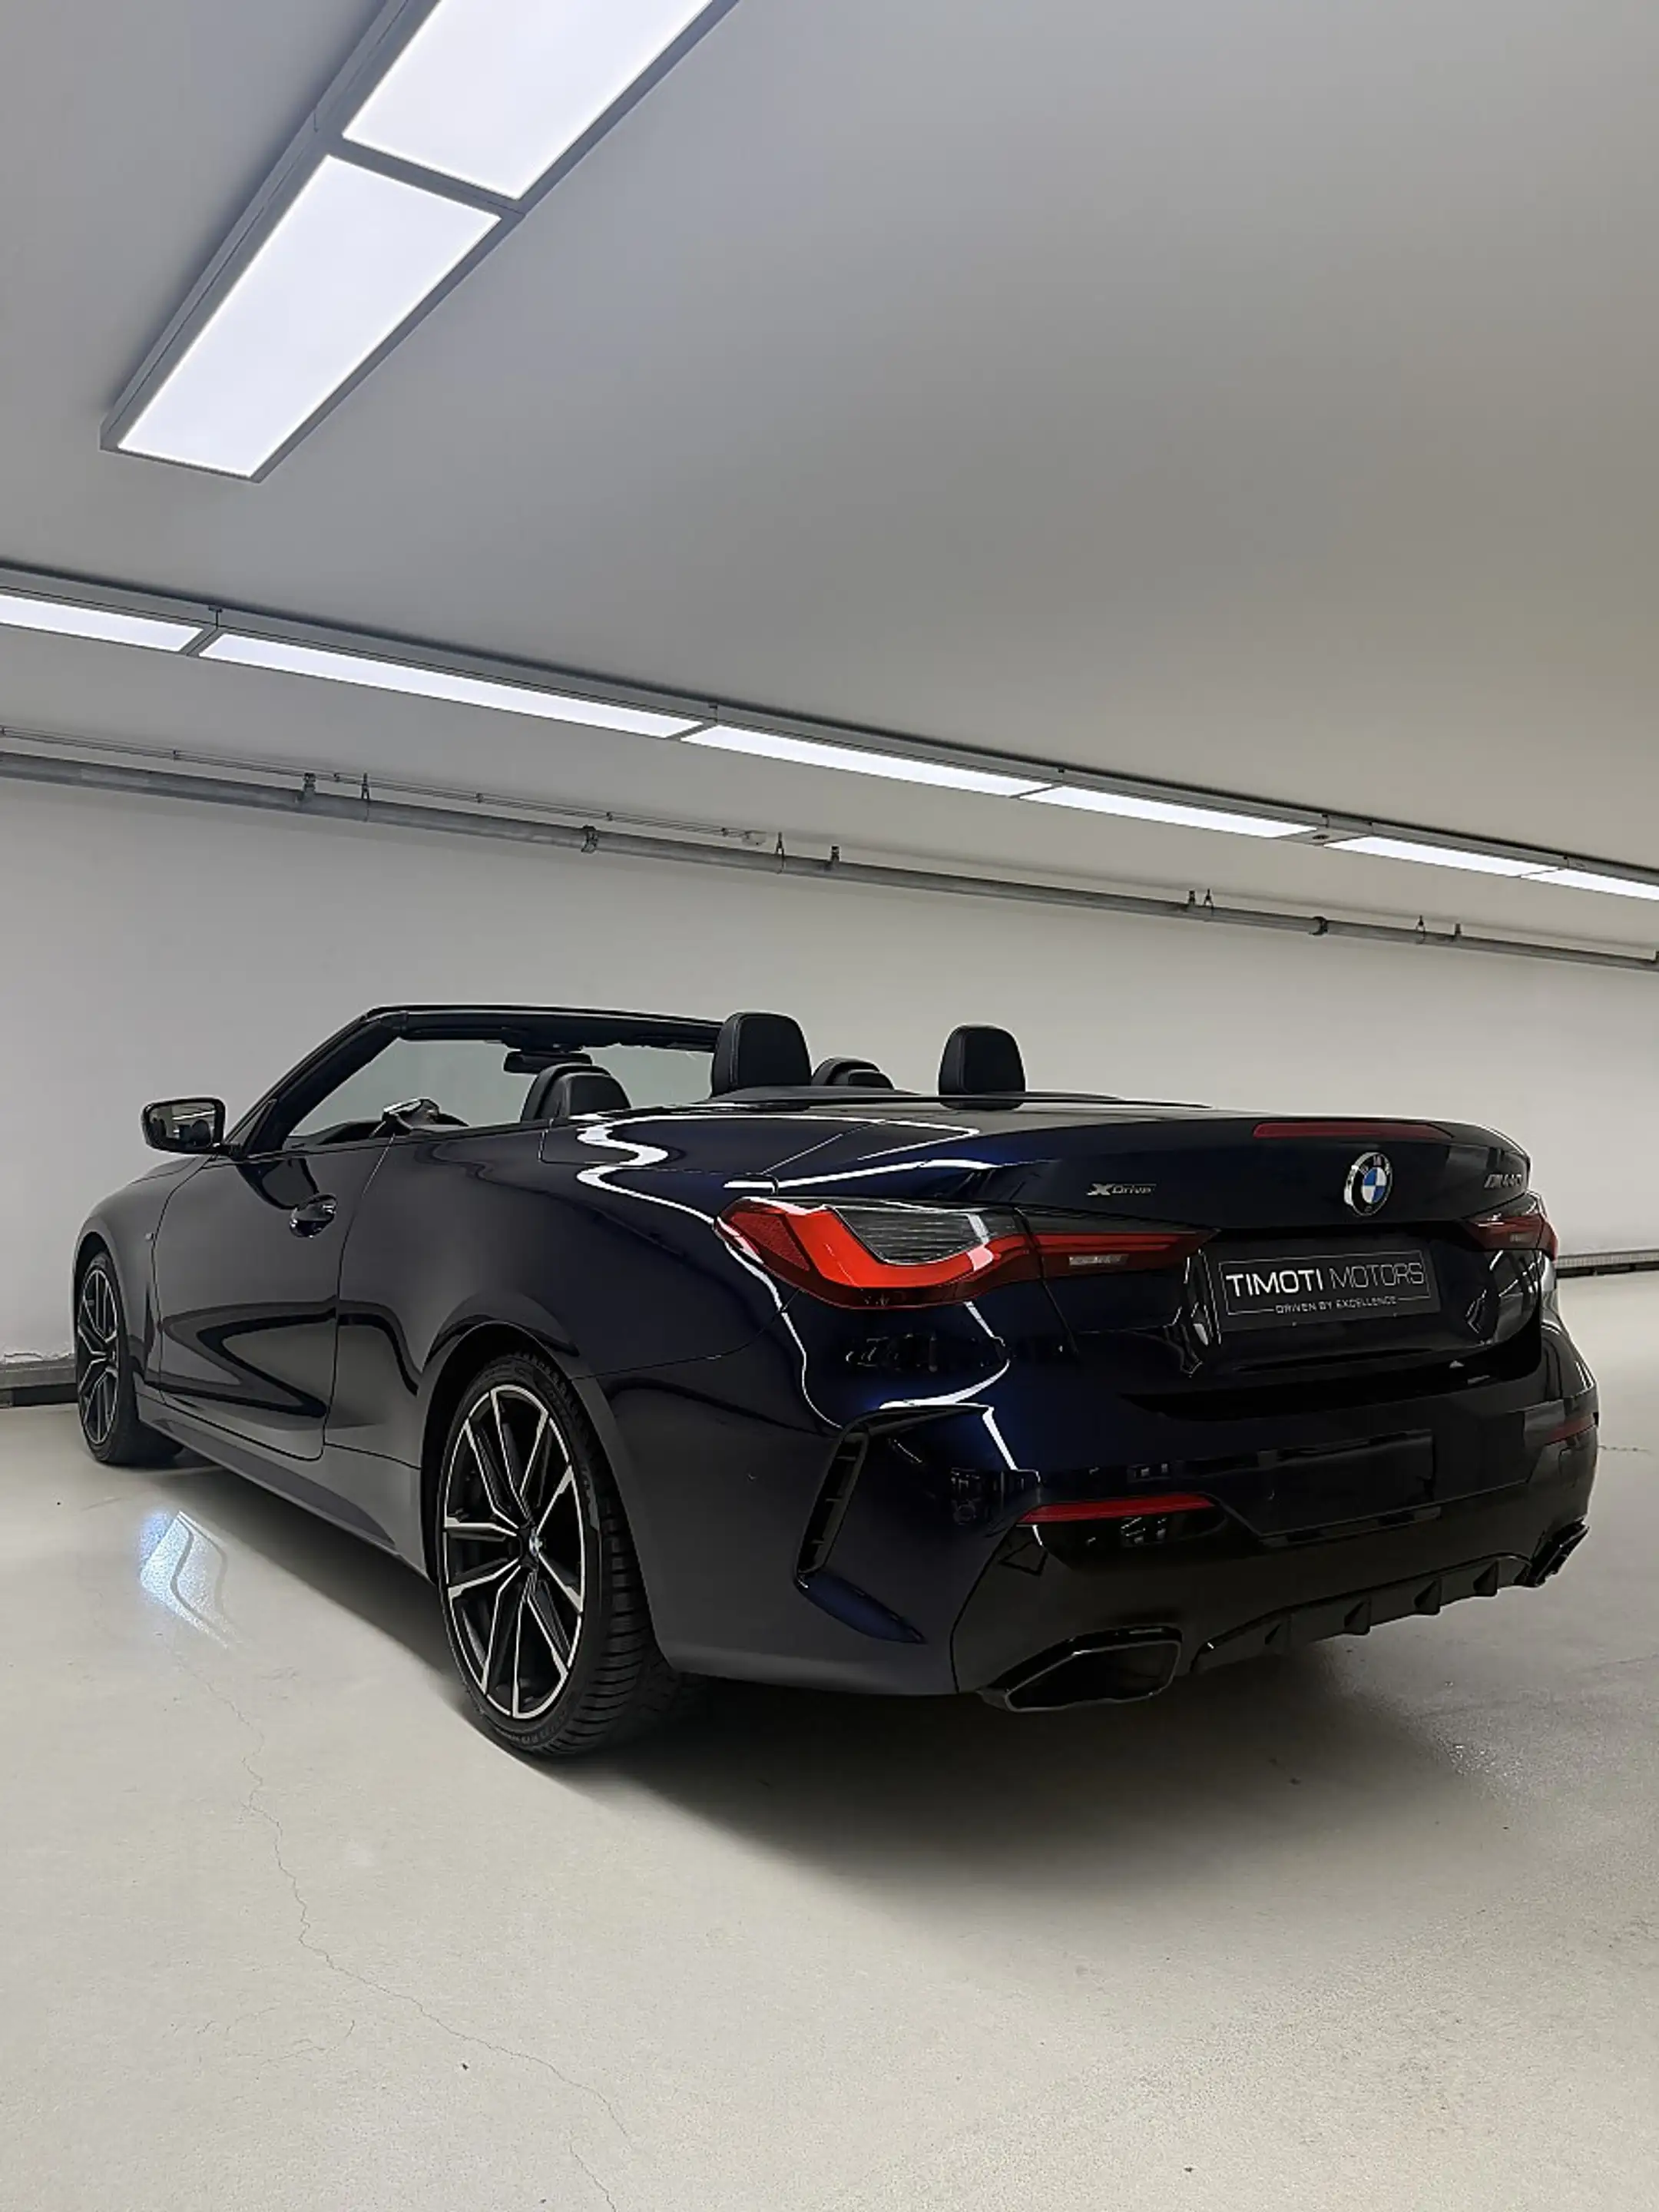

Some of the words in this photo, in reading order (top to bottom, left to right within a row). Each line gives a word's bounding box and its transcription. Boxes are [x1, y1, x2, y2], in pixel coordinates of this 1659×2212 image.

[1226, 1269, 1323, 1296] TIMOTI
[1330, 1263, 1425, 1290] MOTORS
[1275, 1302, 1316, 1314] DRIVEN
[1319, 1301, 1333, 1311] BY
[1336, 1296, 1398, 1309] EXCELLENCE
